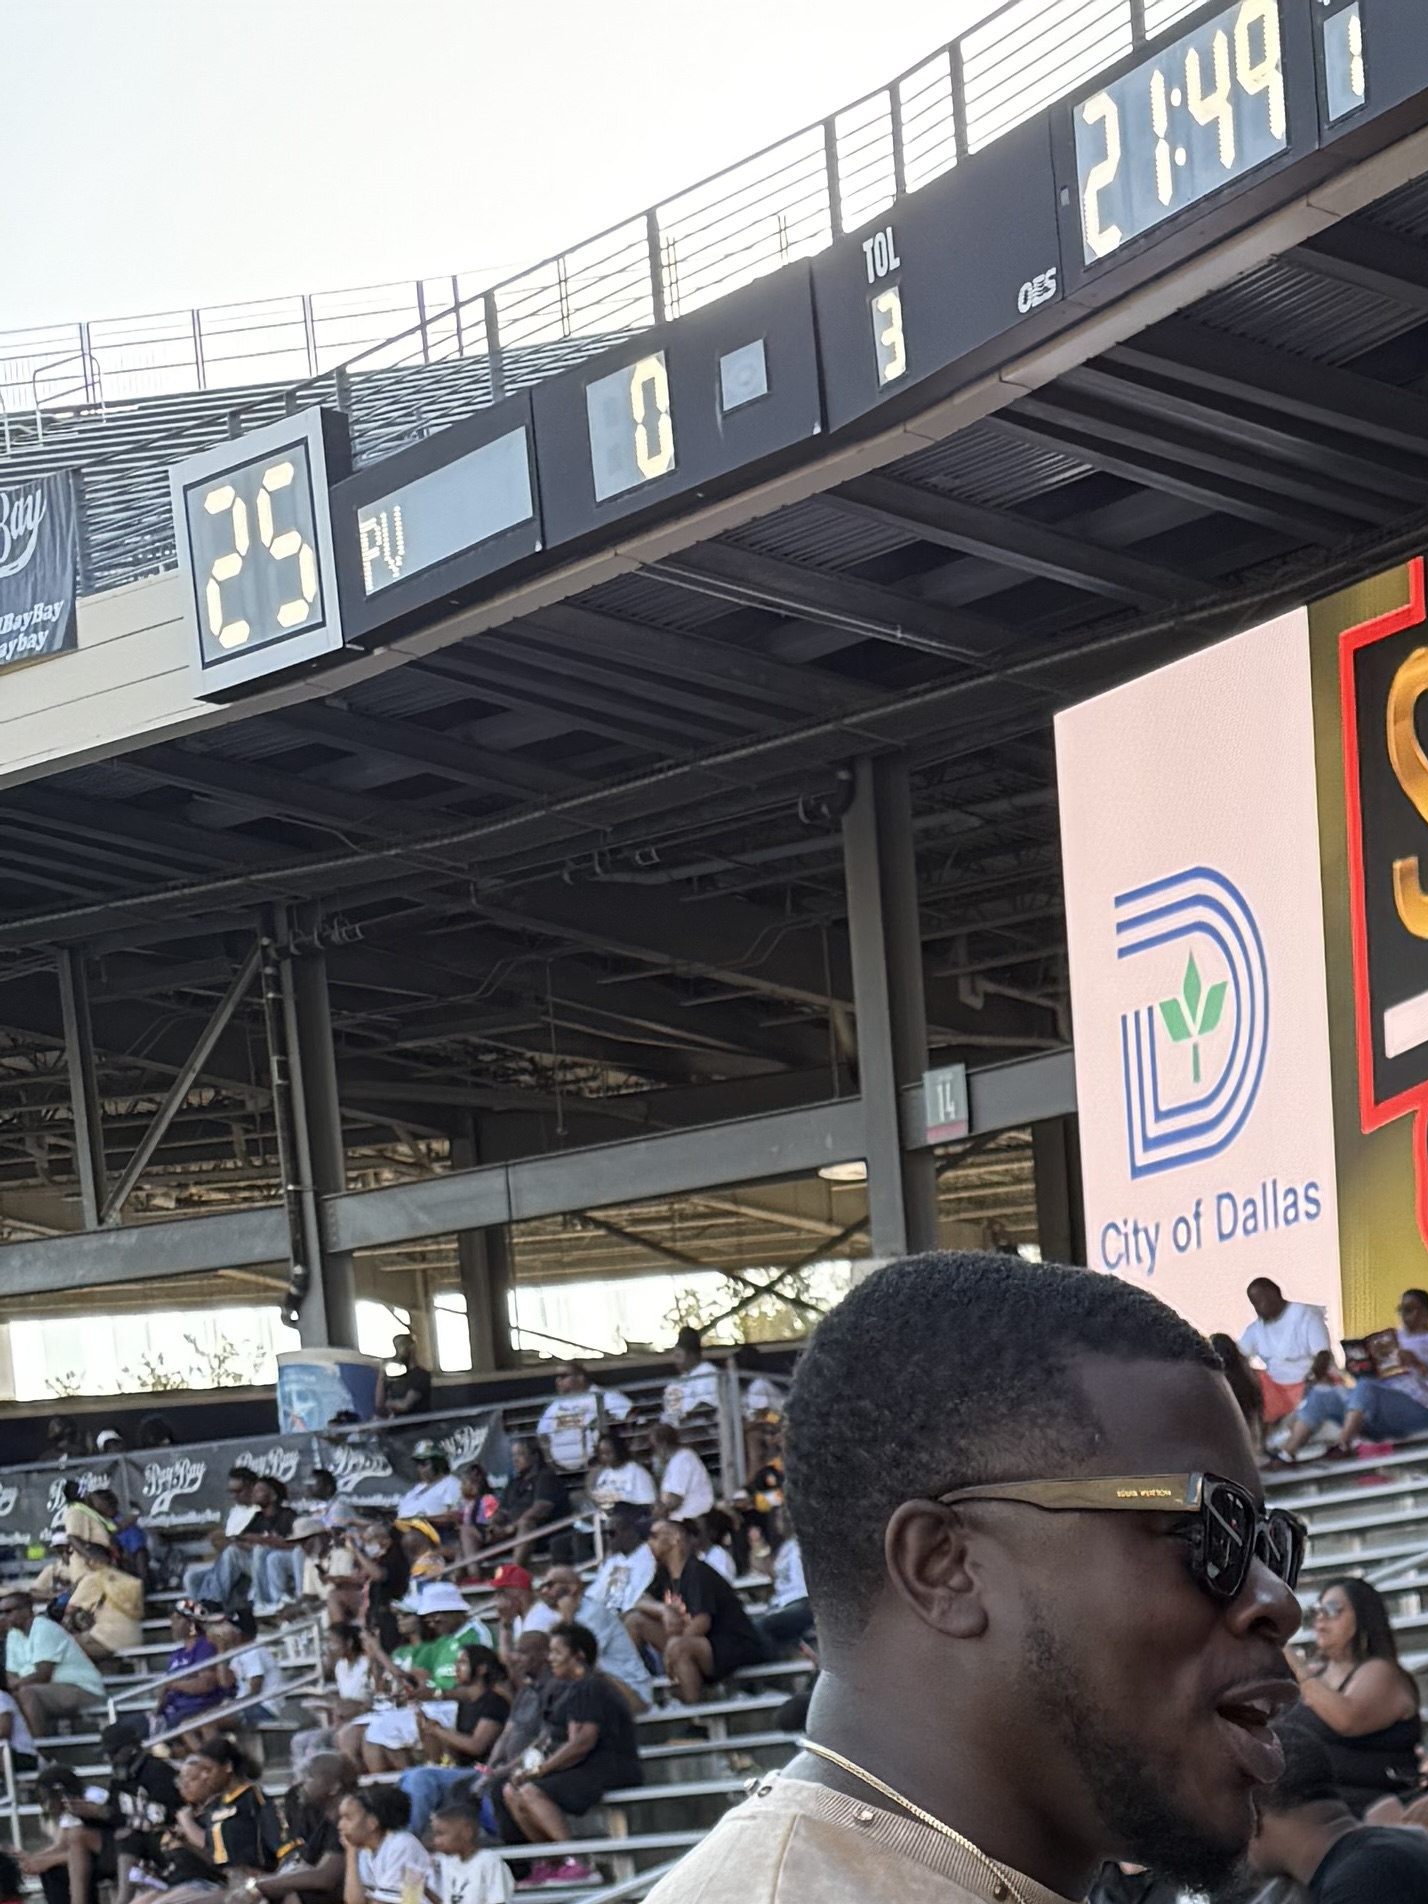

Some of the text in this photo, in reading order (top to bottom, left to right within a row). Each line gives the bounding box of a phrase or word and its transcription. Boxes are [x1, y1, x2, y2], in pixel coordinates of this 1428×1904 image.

[862, 226, 901, 284] TOL
[876, 292, 907, 381] 3
[630, 355, 675, 480] 0
[203, 460, 318, 650] 25
[1100, 1178, 1322, 1276] City of Dallas
